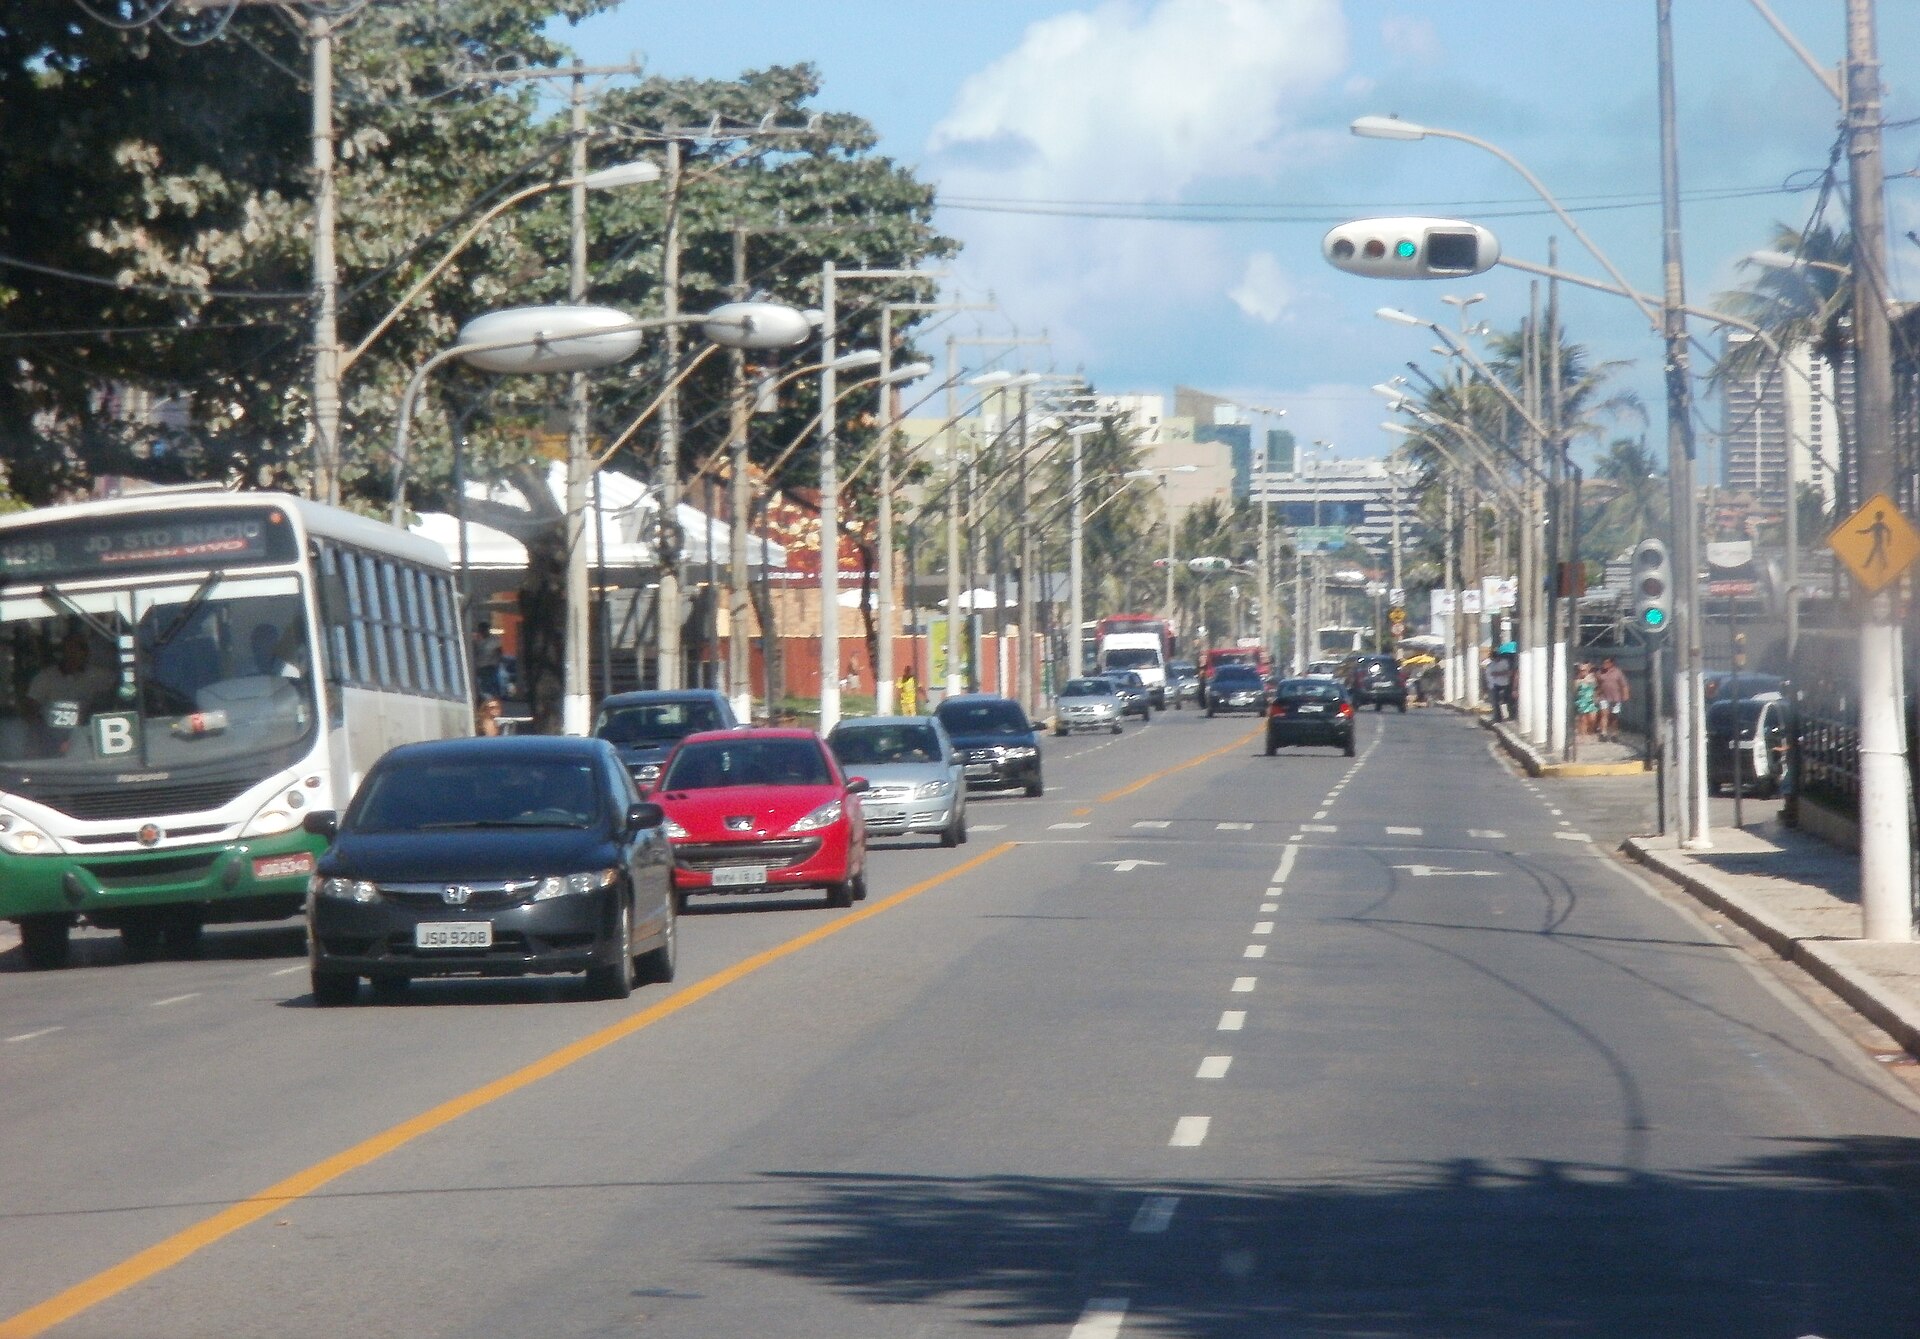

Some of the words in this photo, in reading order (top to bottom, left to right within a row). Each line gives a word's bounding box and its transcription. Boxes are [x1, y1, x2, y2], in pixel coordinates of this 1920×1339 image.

[122, 531, 171, 549] STO
[100, 717, 133, 754] B
[450, 931, 487, 945] 9208
